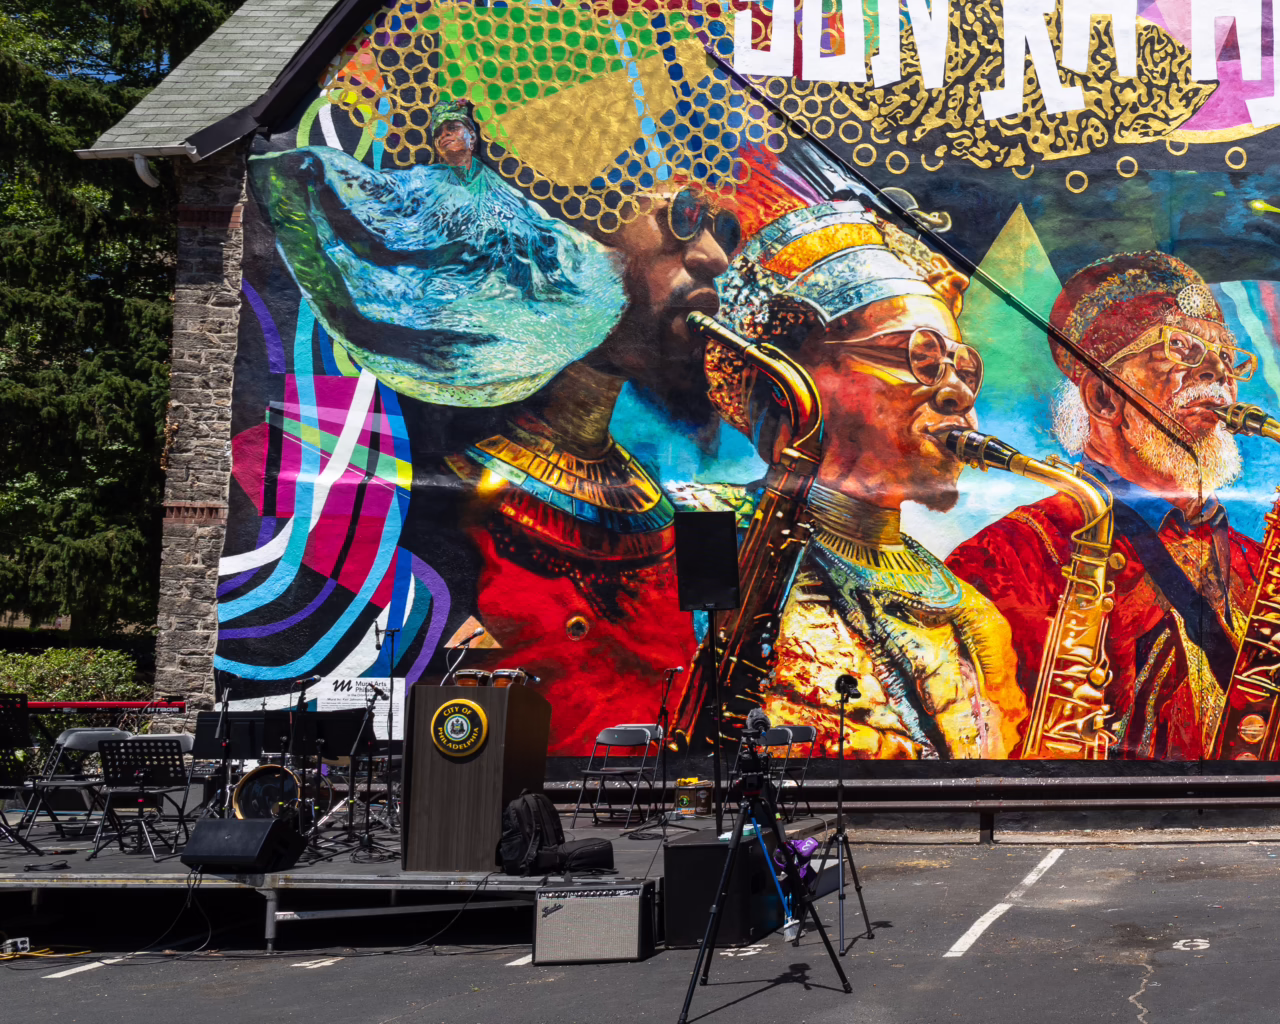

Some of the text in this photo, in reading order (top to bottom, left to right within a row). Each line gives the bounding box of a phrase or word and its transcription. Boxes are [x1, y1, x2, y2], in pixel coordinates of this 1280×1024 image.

[443, 706, 472, 716] CITY OF
[438, 727, 479, 750] PHILADELPHIA
[1172, 938, 1211, 951] 6
